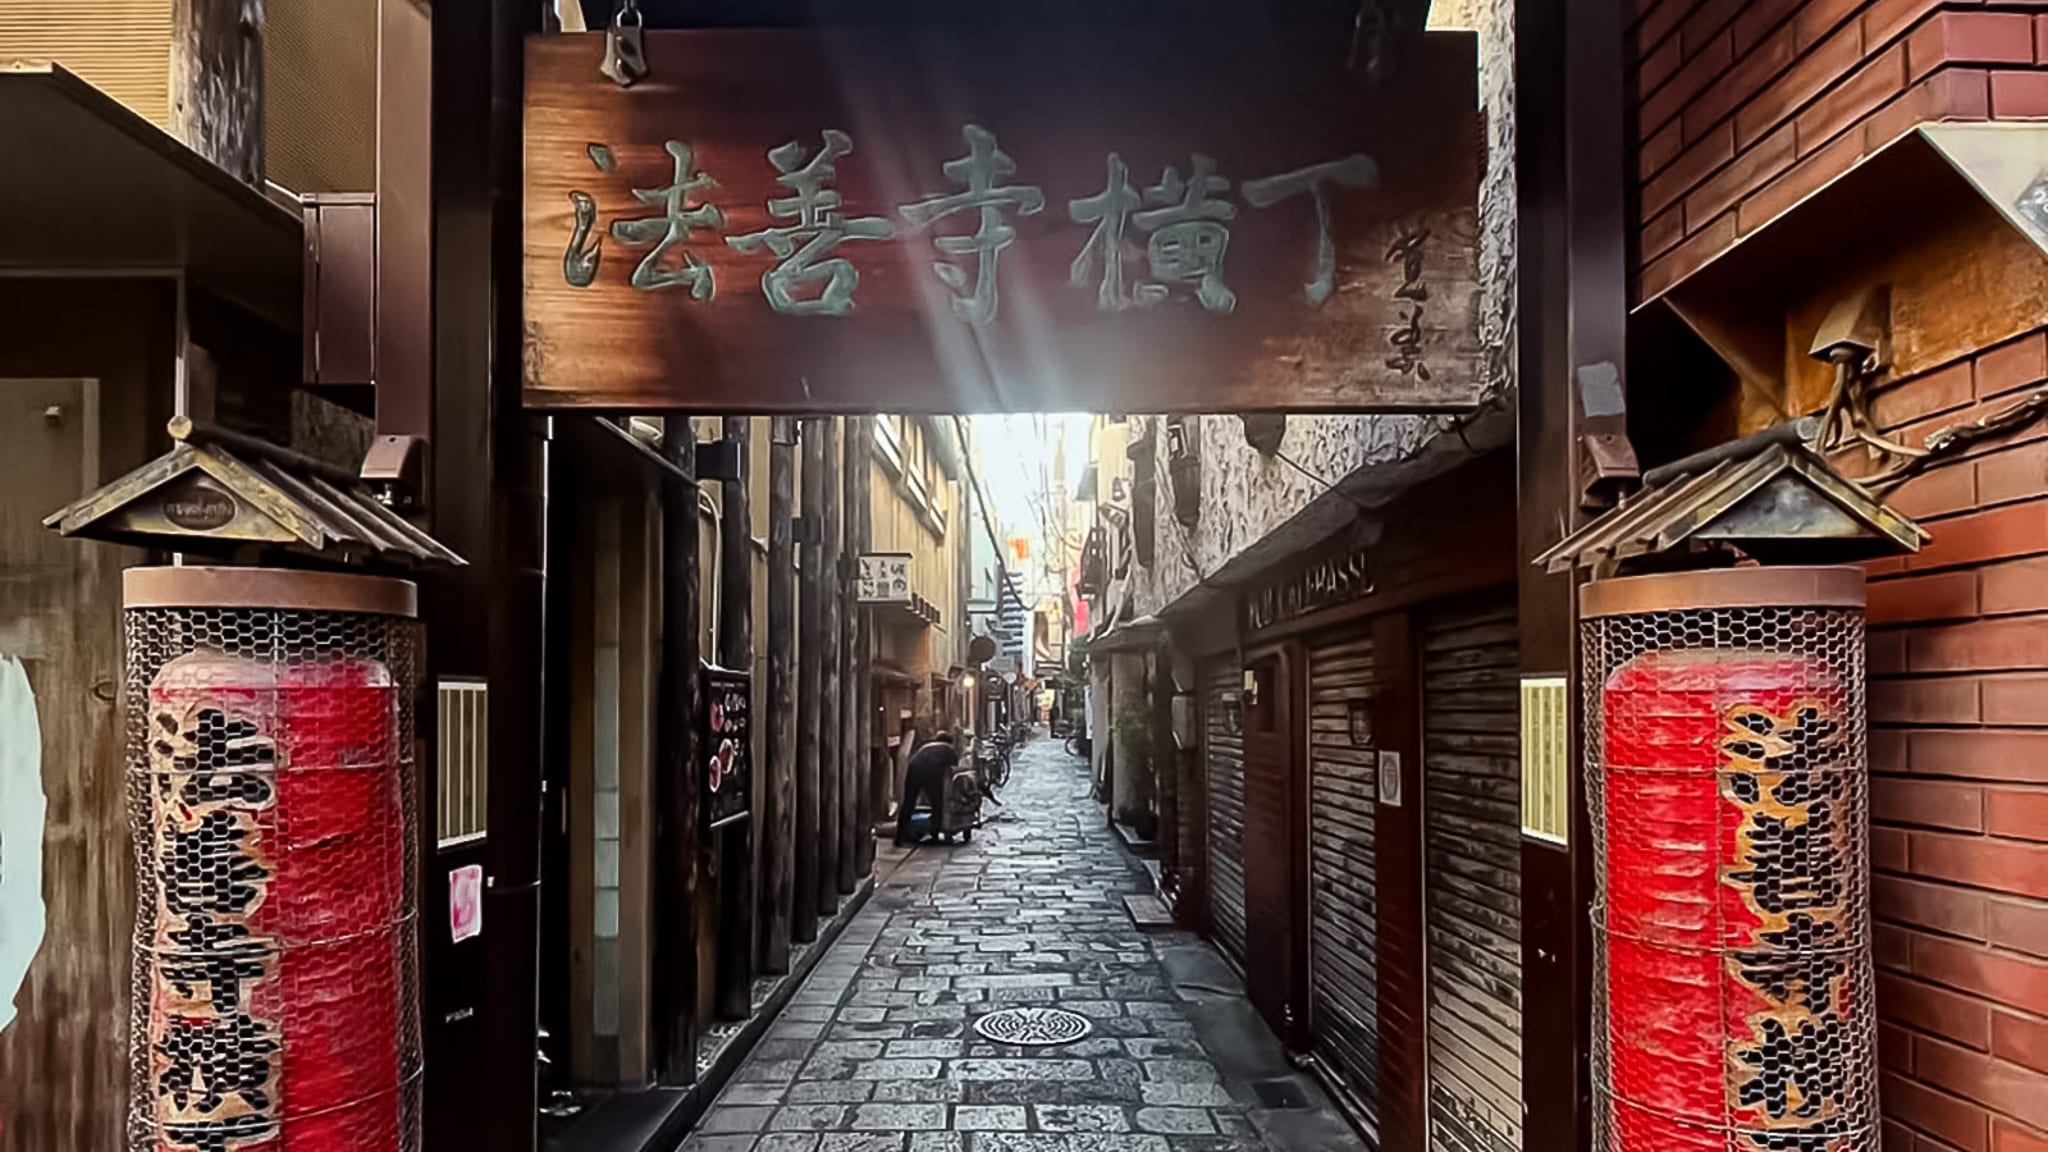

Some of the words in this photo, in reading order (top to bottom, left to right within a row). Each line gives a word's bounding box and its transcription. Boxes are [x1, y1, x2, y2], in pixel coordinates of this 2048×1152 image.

[563, 124, 1378, 325] 法善寺横丁
